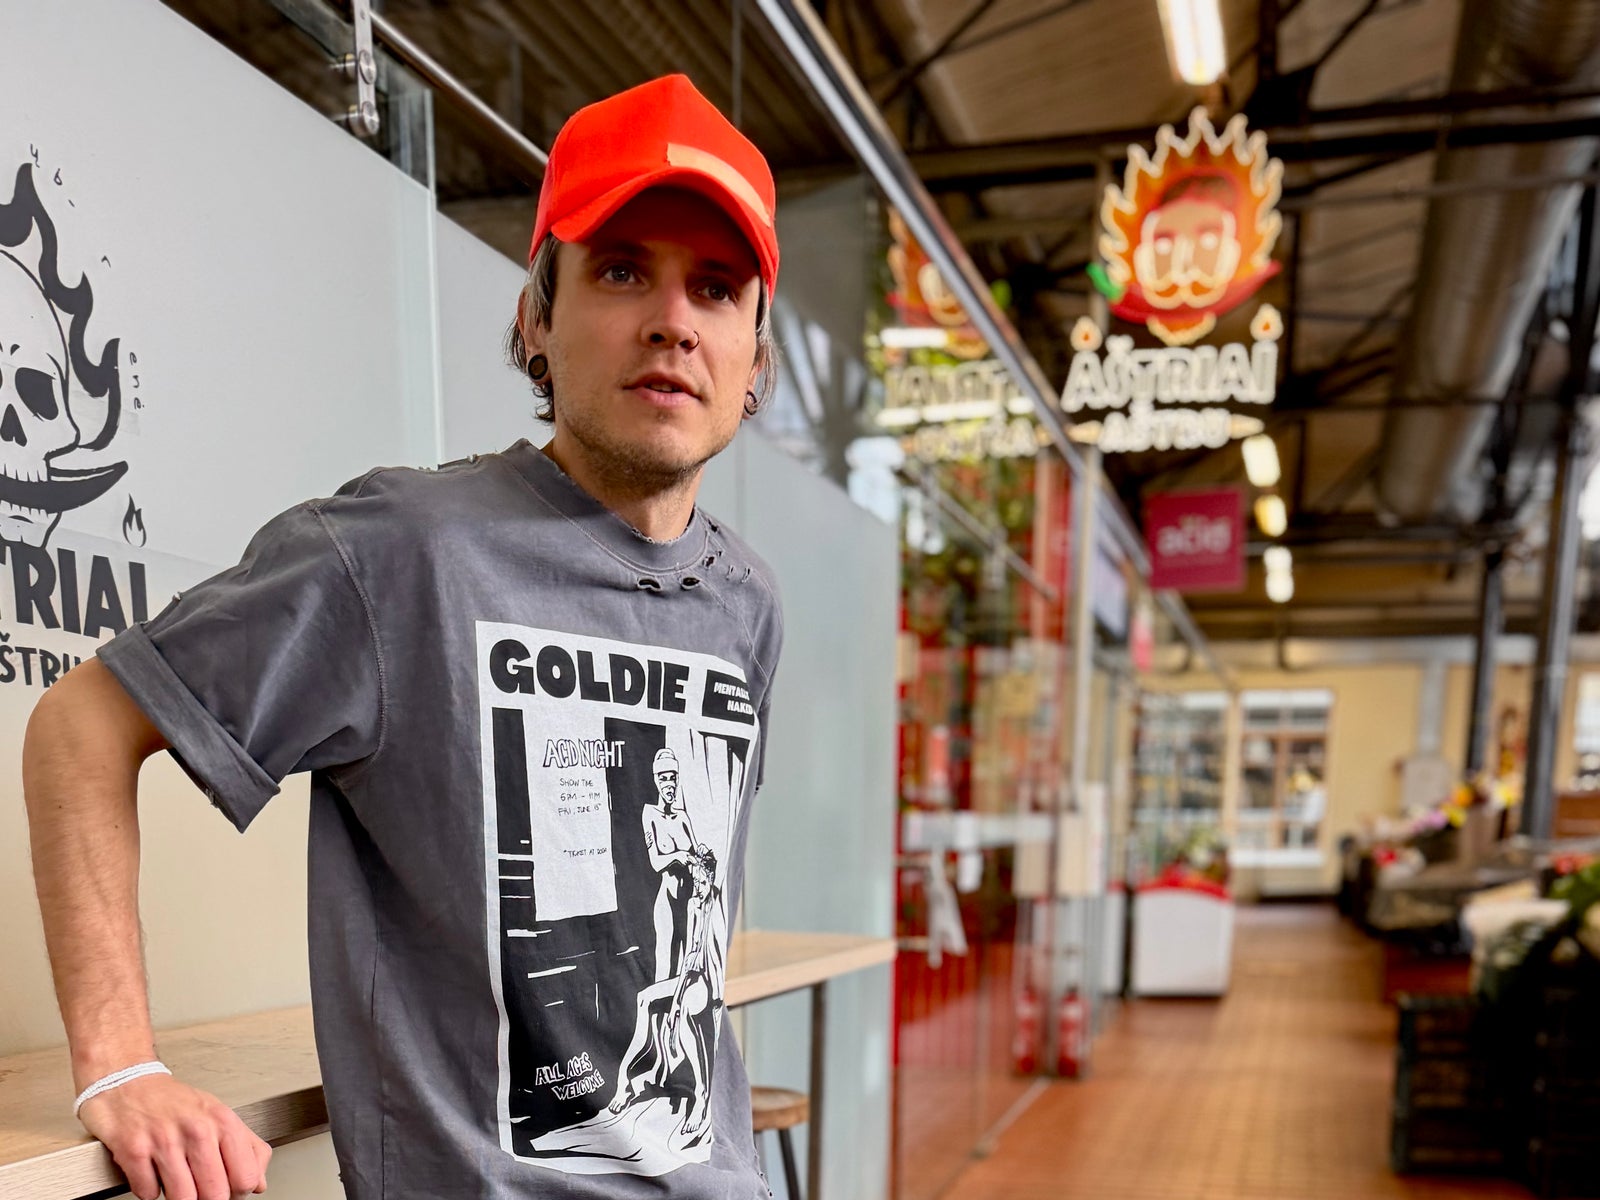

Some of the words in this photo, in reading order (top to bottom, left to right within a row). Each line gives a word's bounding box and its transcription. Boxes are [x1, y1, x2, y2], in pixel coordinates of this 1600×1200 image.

[489, 639, 690, 714] GOLDIE
[542, 739, 580, 769] ACID
[578, 738, 626, 769] NIGHT
[535, 1062, 566, 1086] ALL
[566, 1051, 593, 1080] AGES
[551, 1068, 606, 1100] WELCOME
